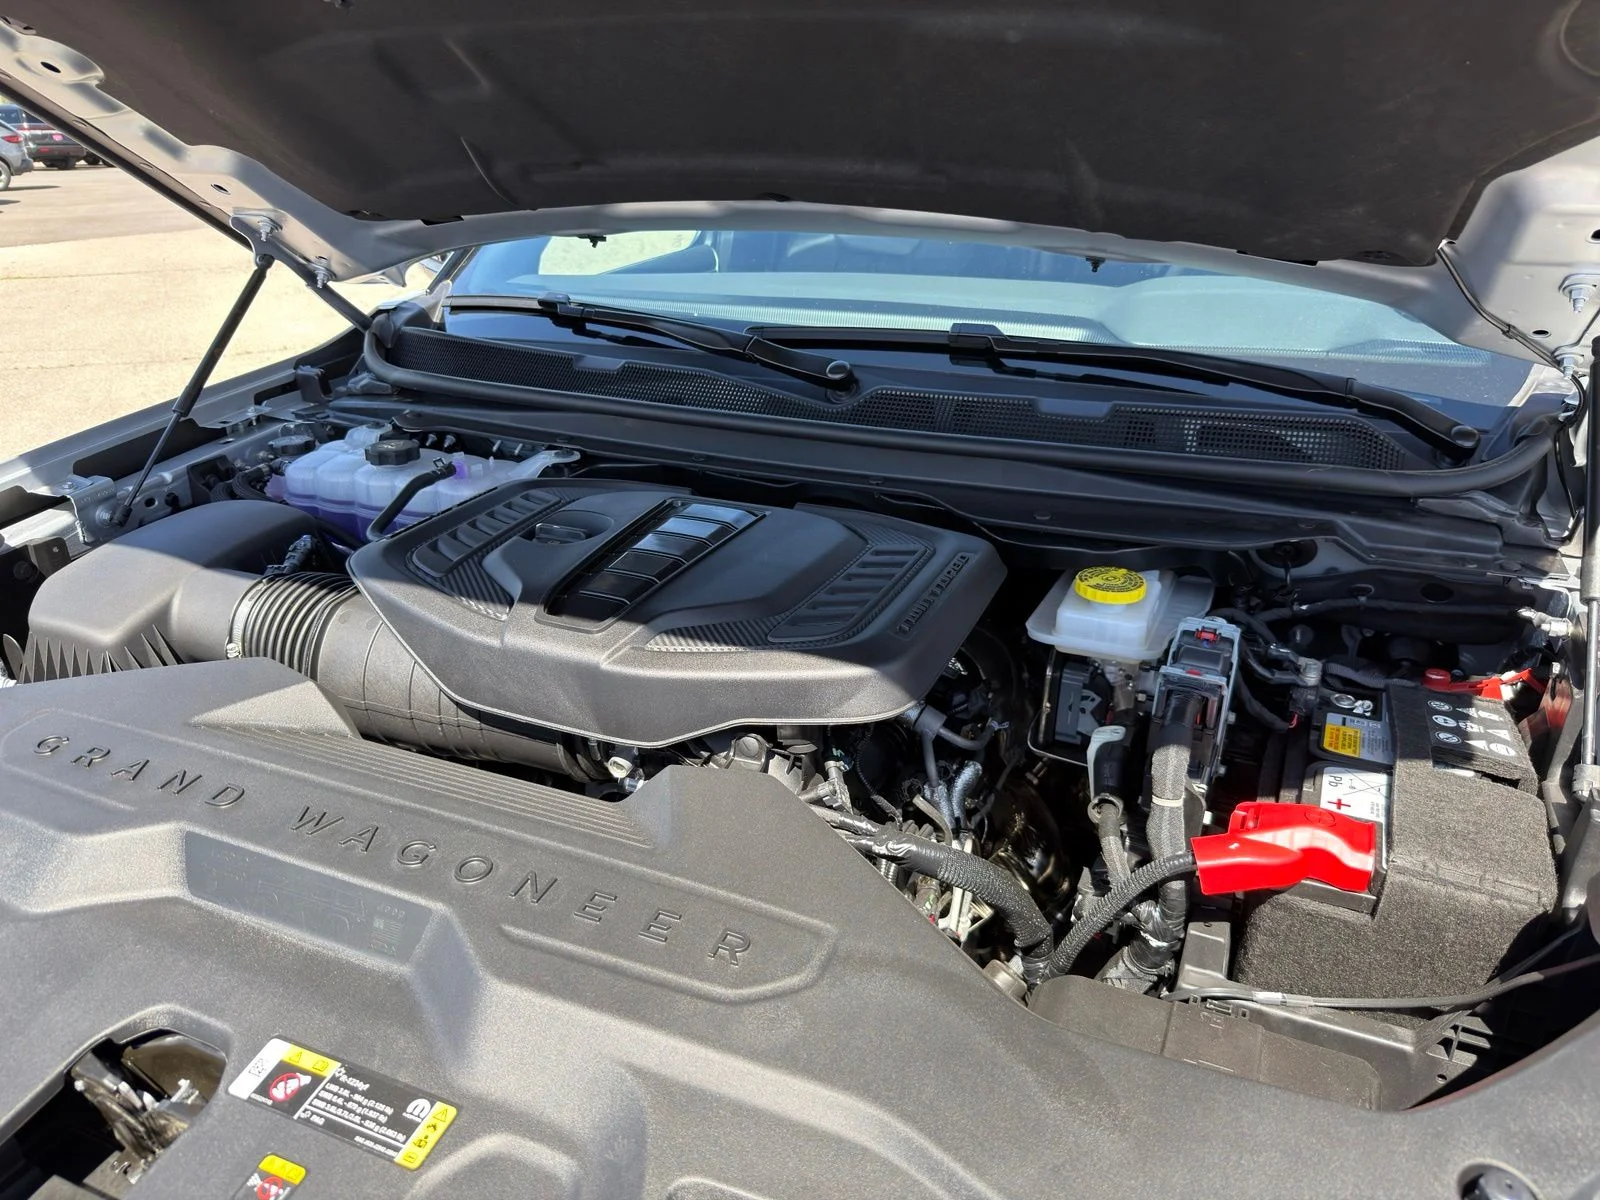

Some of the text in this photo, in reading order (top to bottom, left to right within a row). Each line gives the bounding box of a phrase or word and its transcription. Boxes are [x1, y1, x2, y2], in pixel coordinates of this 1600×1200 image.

[1328, 774, 1343, 787] Pb
[32, 735, 752, 968] GRAND WAGONEER
